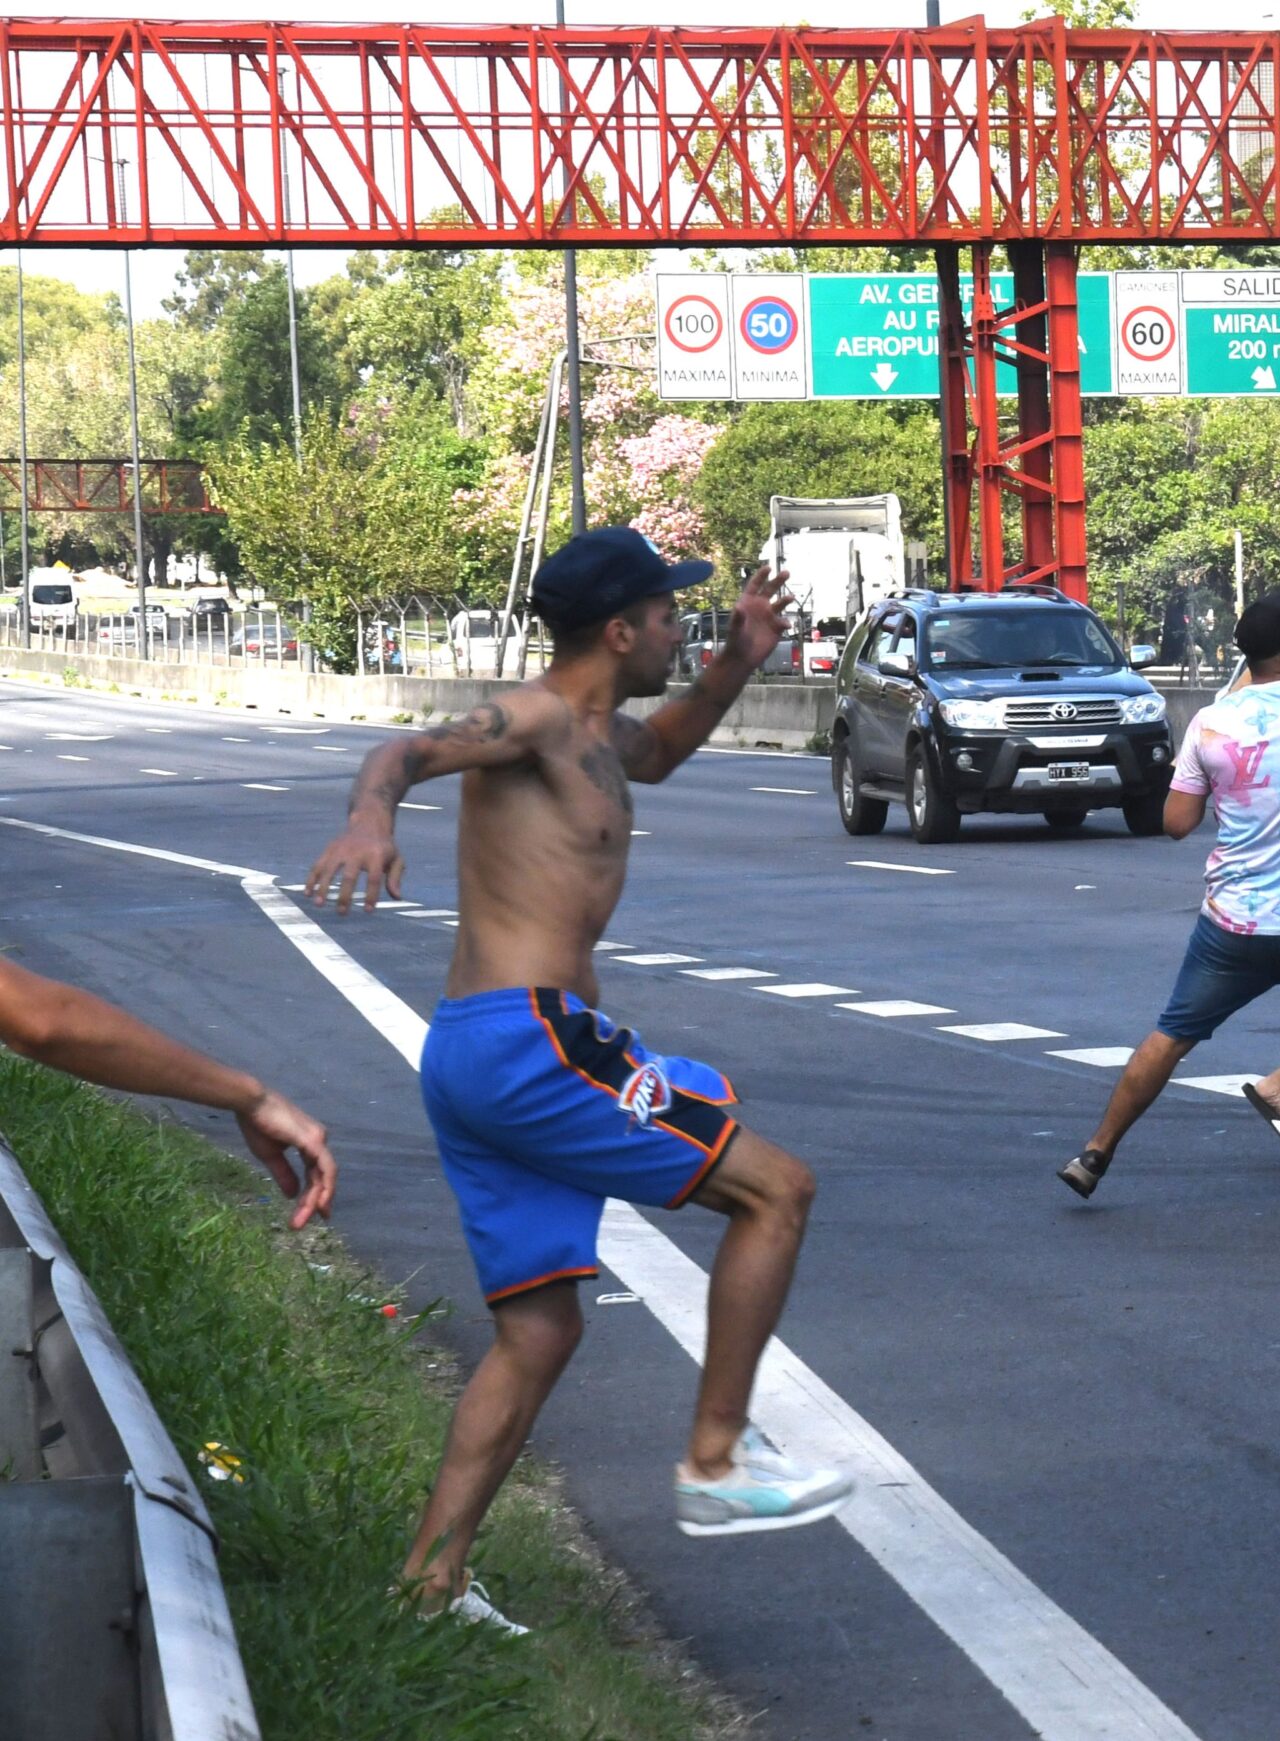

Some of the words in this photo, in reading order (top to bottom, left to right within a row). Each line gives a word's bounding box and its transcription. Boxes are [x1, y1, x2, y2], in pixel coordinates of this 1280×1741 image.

[859, 283, 893, 305] AV.
[675, 314, 715, 334] 100
[750, 312, 788, 338] 50
[883, 309, 917, 331] AU
[1132, 322, 1165, 346] 60
[1227, 339, 1267, 360] 200
[664, 369, 727, 382] MAXIMA
[742, 370, 799, 382] MINIMA
[1120, 372, 1178, 384] MAXIMA
[1049, 768, 1066, 778] HYX
